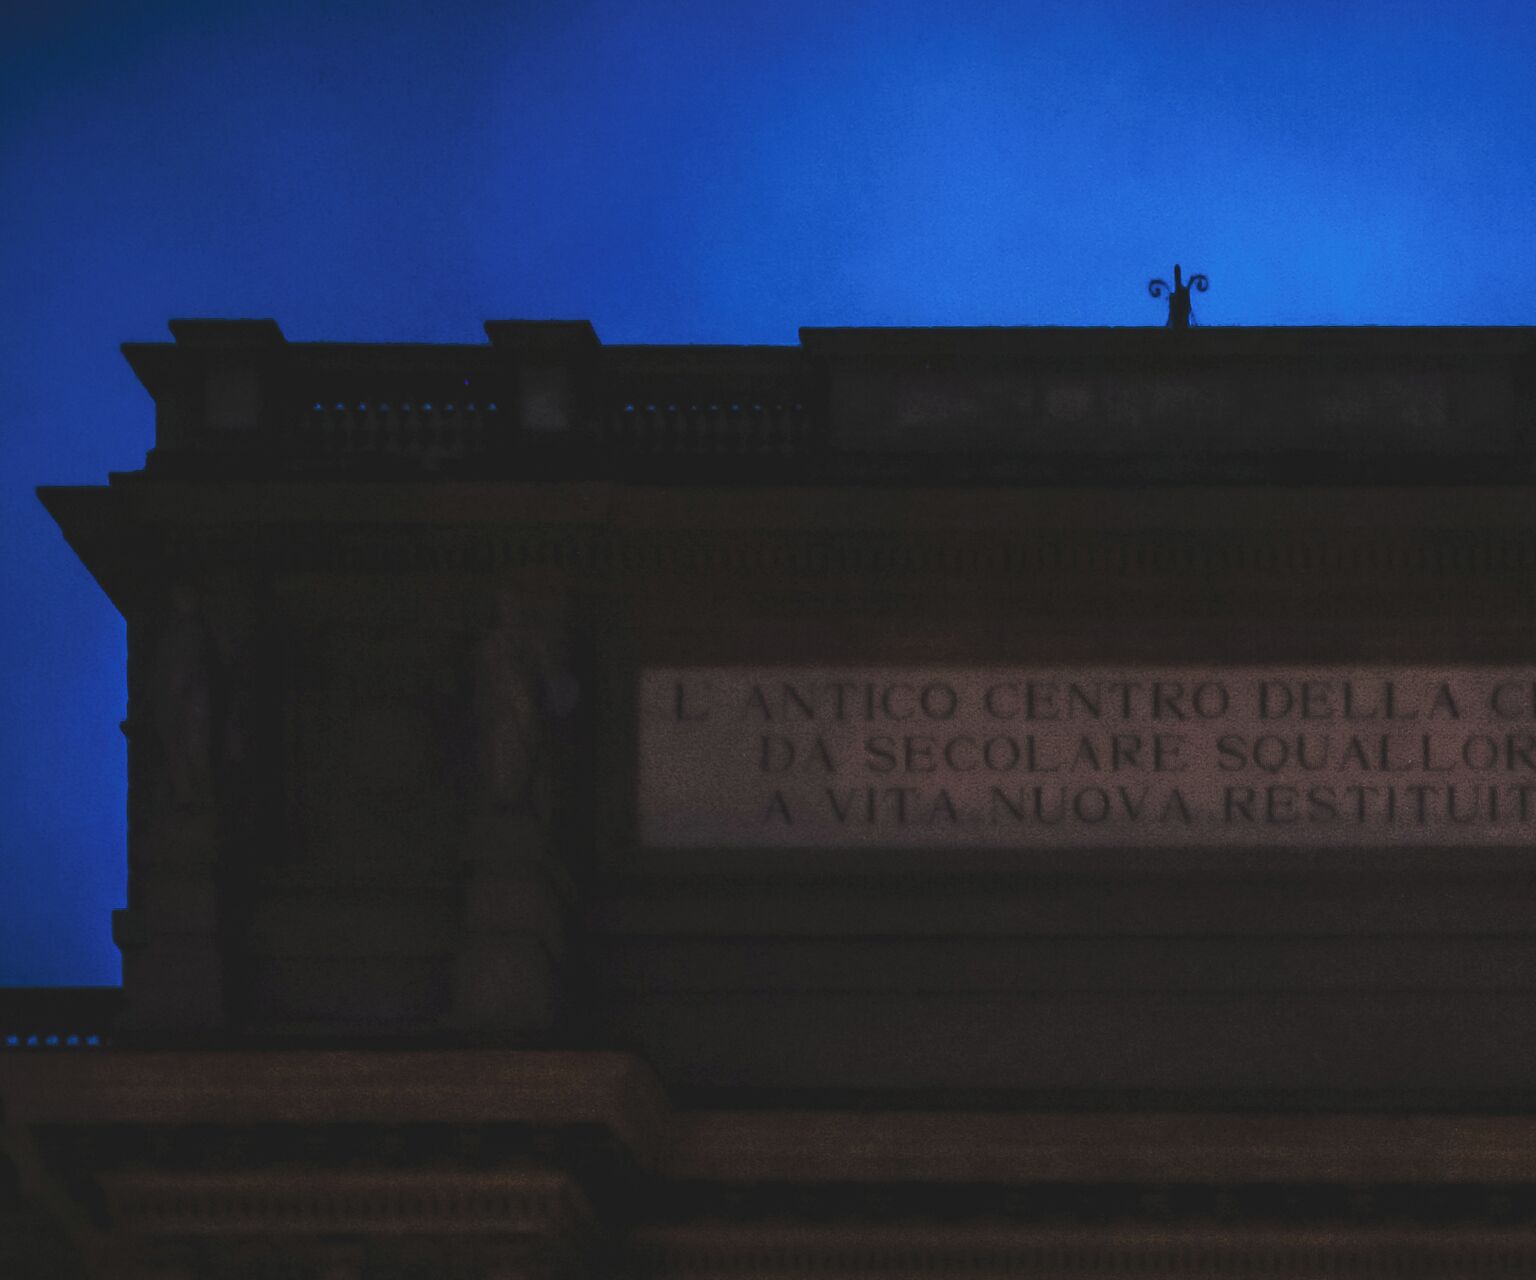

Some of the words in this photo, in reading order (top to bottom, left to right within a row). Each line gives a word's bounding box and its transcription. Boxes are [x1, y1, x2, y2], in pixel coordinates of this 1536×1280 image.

[741, 682, 958, 722] ANTICO
[983, 682, 1230, 722] CENTRO
[1257, 681, 1461, 721] DELLA
[759, 735, 836, 773] DA
[863, 735, 1188, 773] SECOLARE
[763, 790, 793, 826] A
[826, 787, 961, 826] VITA
[991, 786, 1192, 826] NUOVA
